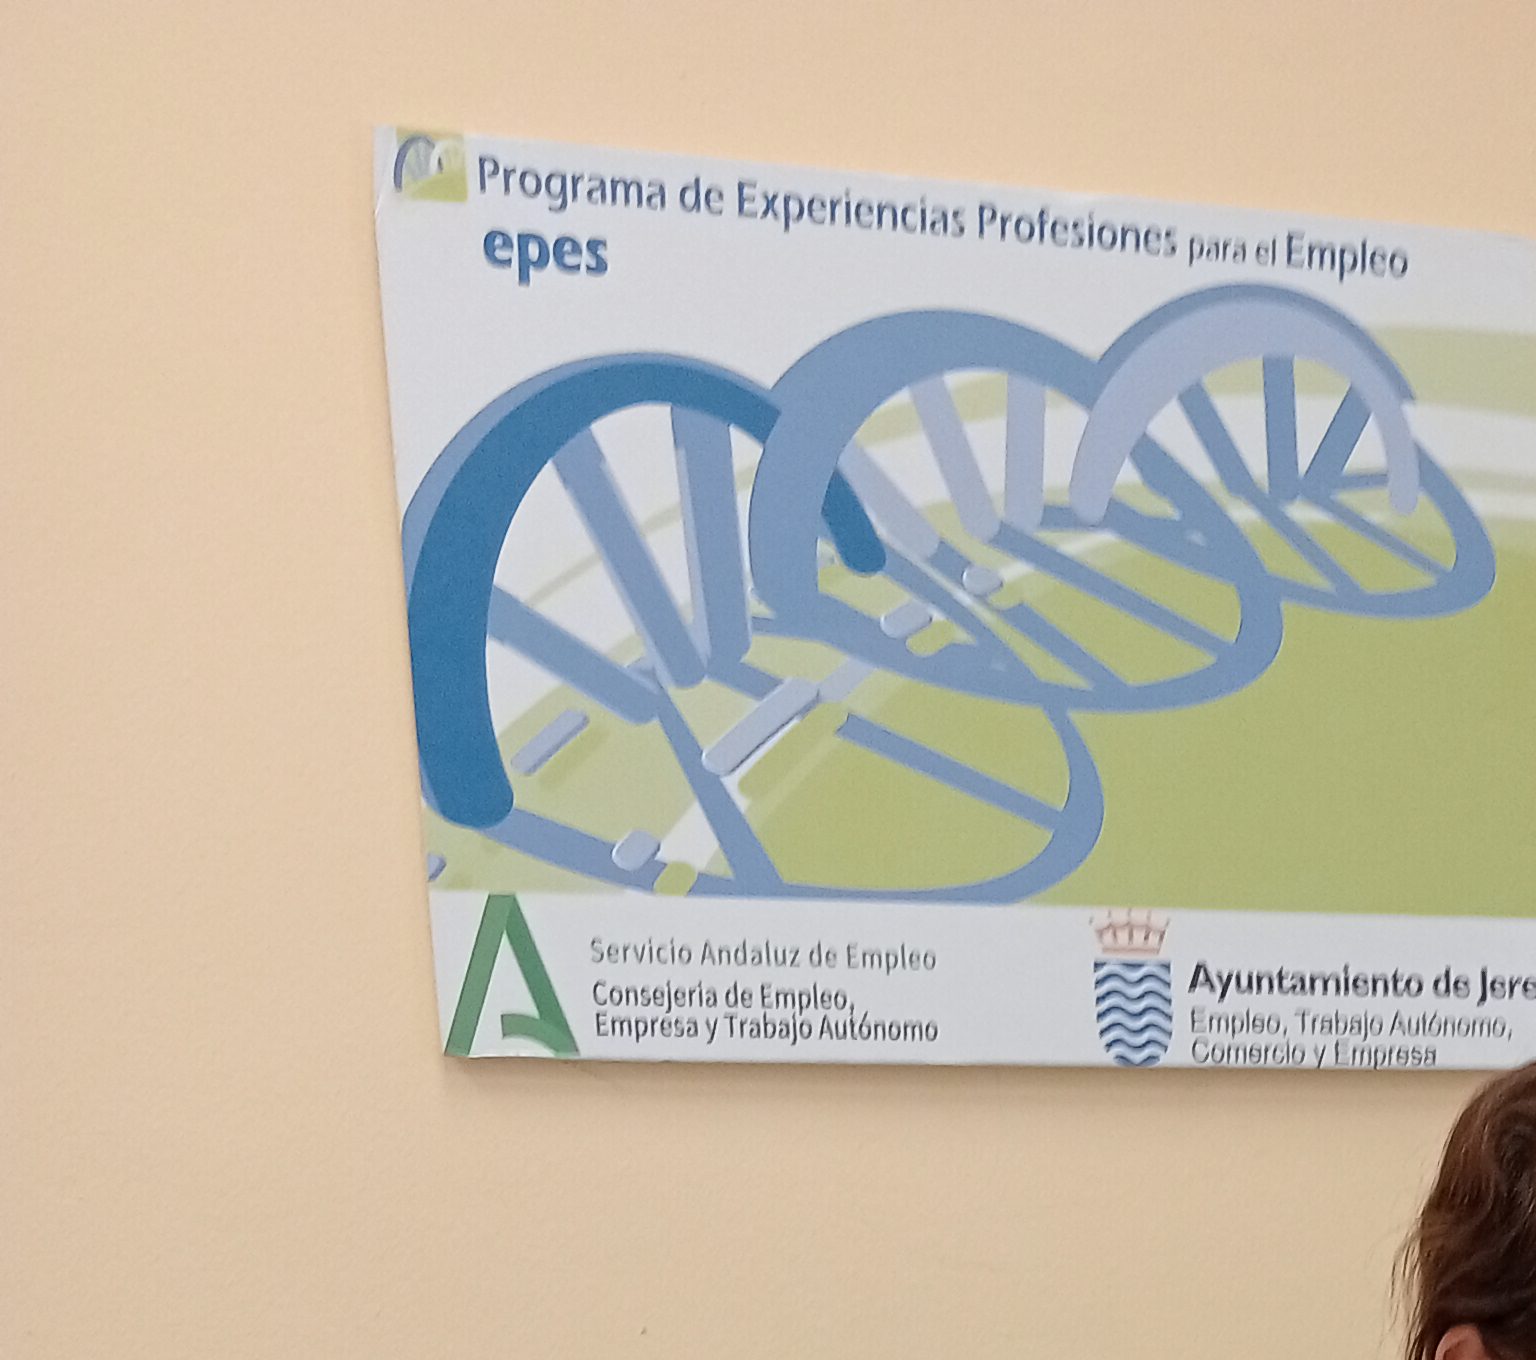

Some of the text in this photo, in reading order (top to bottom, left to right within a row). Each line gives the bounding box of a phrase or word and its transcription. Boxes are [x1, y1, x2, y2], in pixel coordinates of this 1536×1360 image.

[477, 154, 1409, 284] Programa de Experiencias Profesiones para el Empleo
[483, 227, 609, 287] epes
[590, 936, 937, 976] Servicio Andaluz de Empleo
[724, 981, 754, 1010] de
[760, 982, 855, 1015] Empleo,
[1187, 961, 1424, 1003] Ayuntamiento
[1432, 966, 1471, 999] de
[595, 1011, 939, 1046] Empresa y Trabajo Autónomo
[1190, 1008, 1514, 1042] Empleo, Trabajo Autónomo,
[1190, 1038, 1436, 1068] Comercio y Empresa
